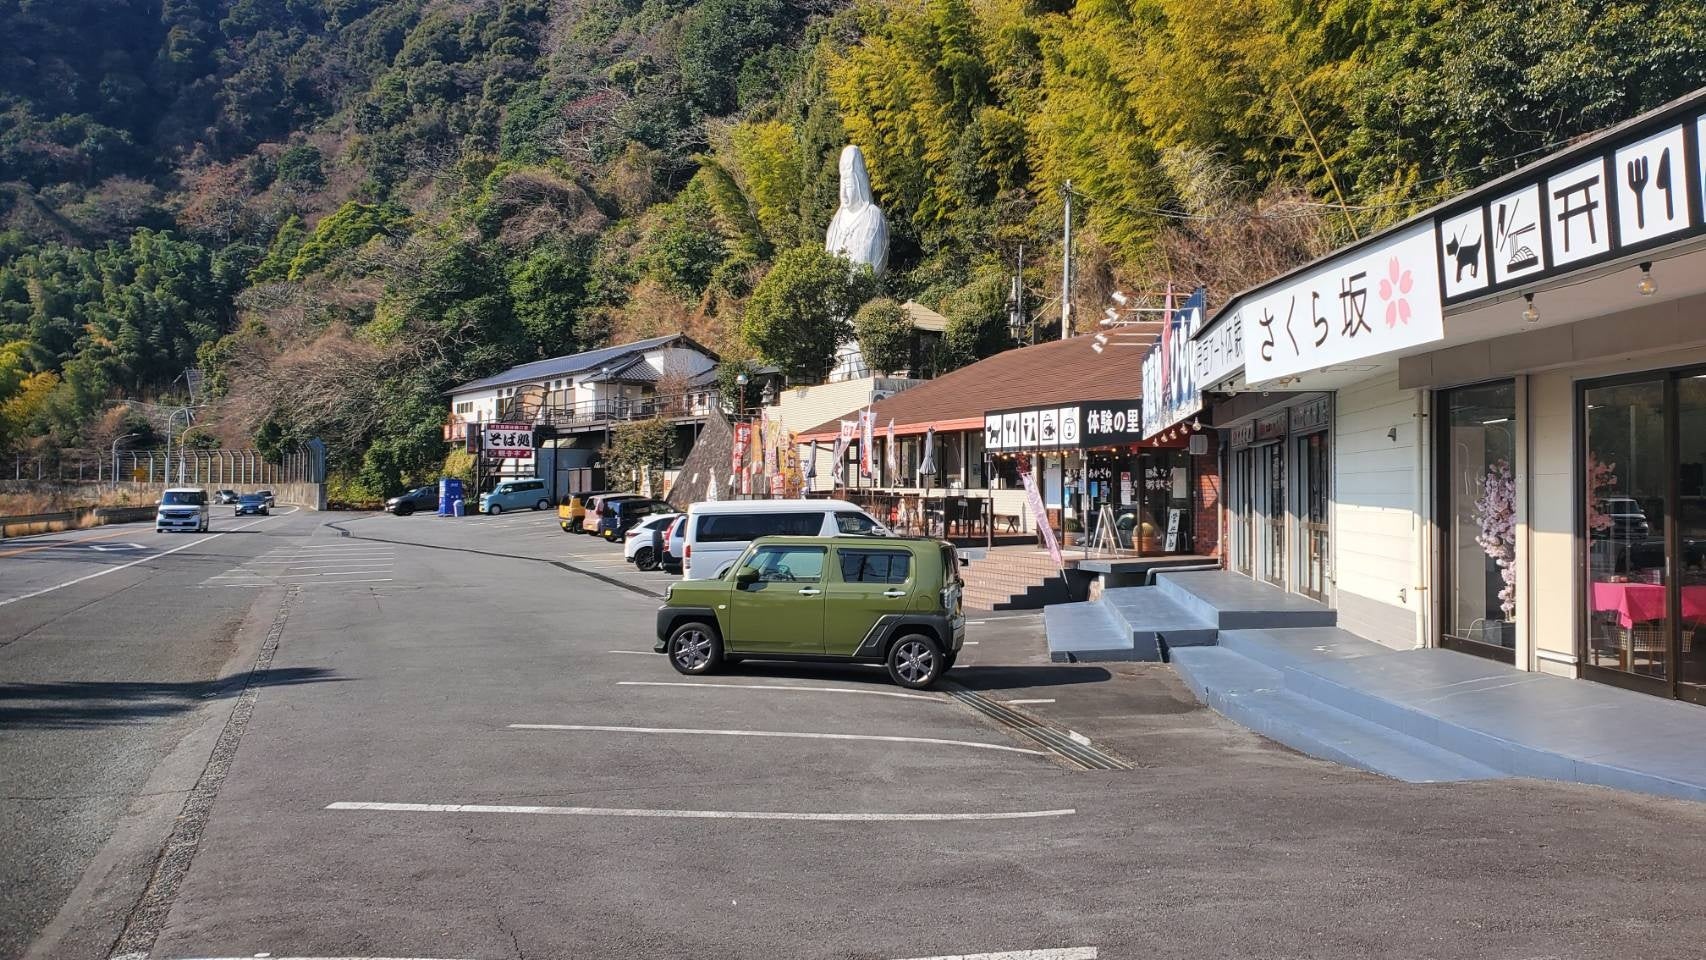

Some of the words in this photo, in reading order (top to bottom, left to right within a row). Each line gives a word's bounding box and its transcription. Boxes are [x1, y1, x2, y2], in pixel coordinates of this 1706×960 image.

[1259, 270, 1372, 361] さくら坂
[1087, 409, 1140, 434] 体験の里
[489, 432, 530, 447] そば処
